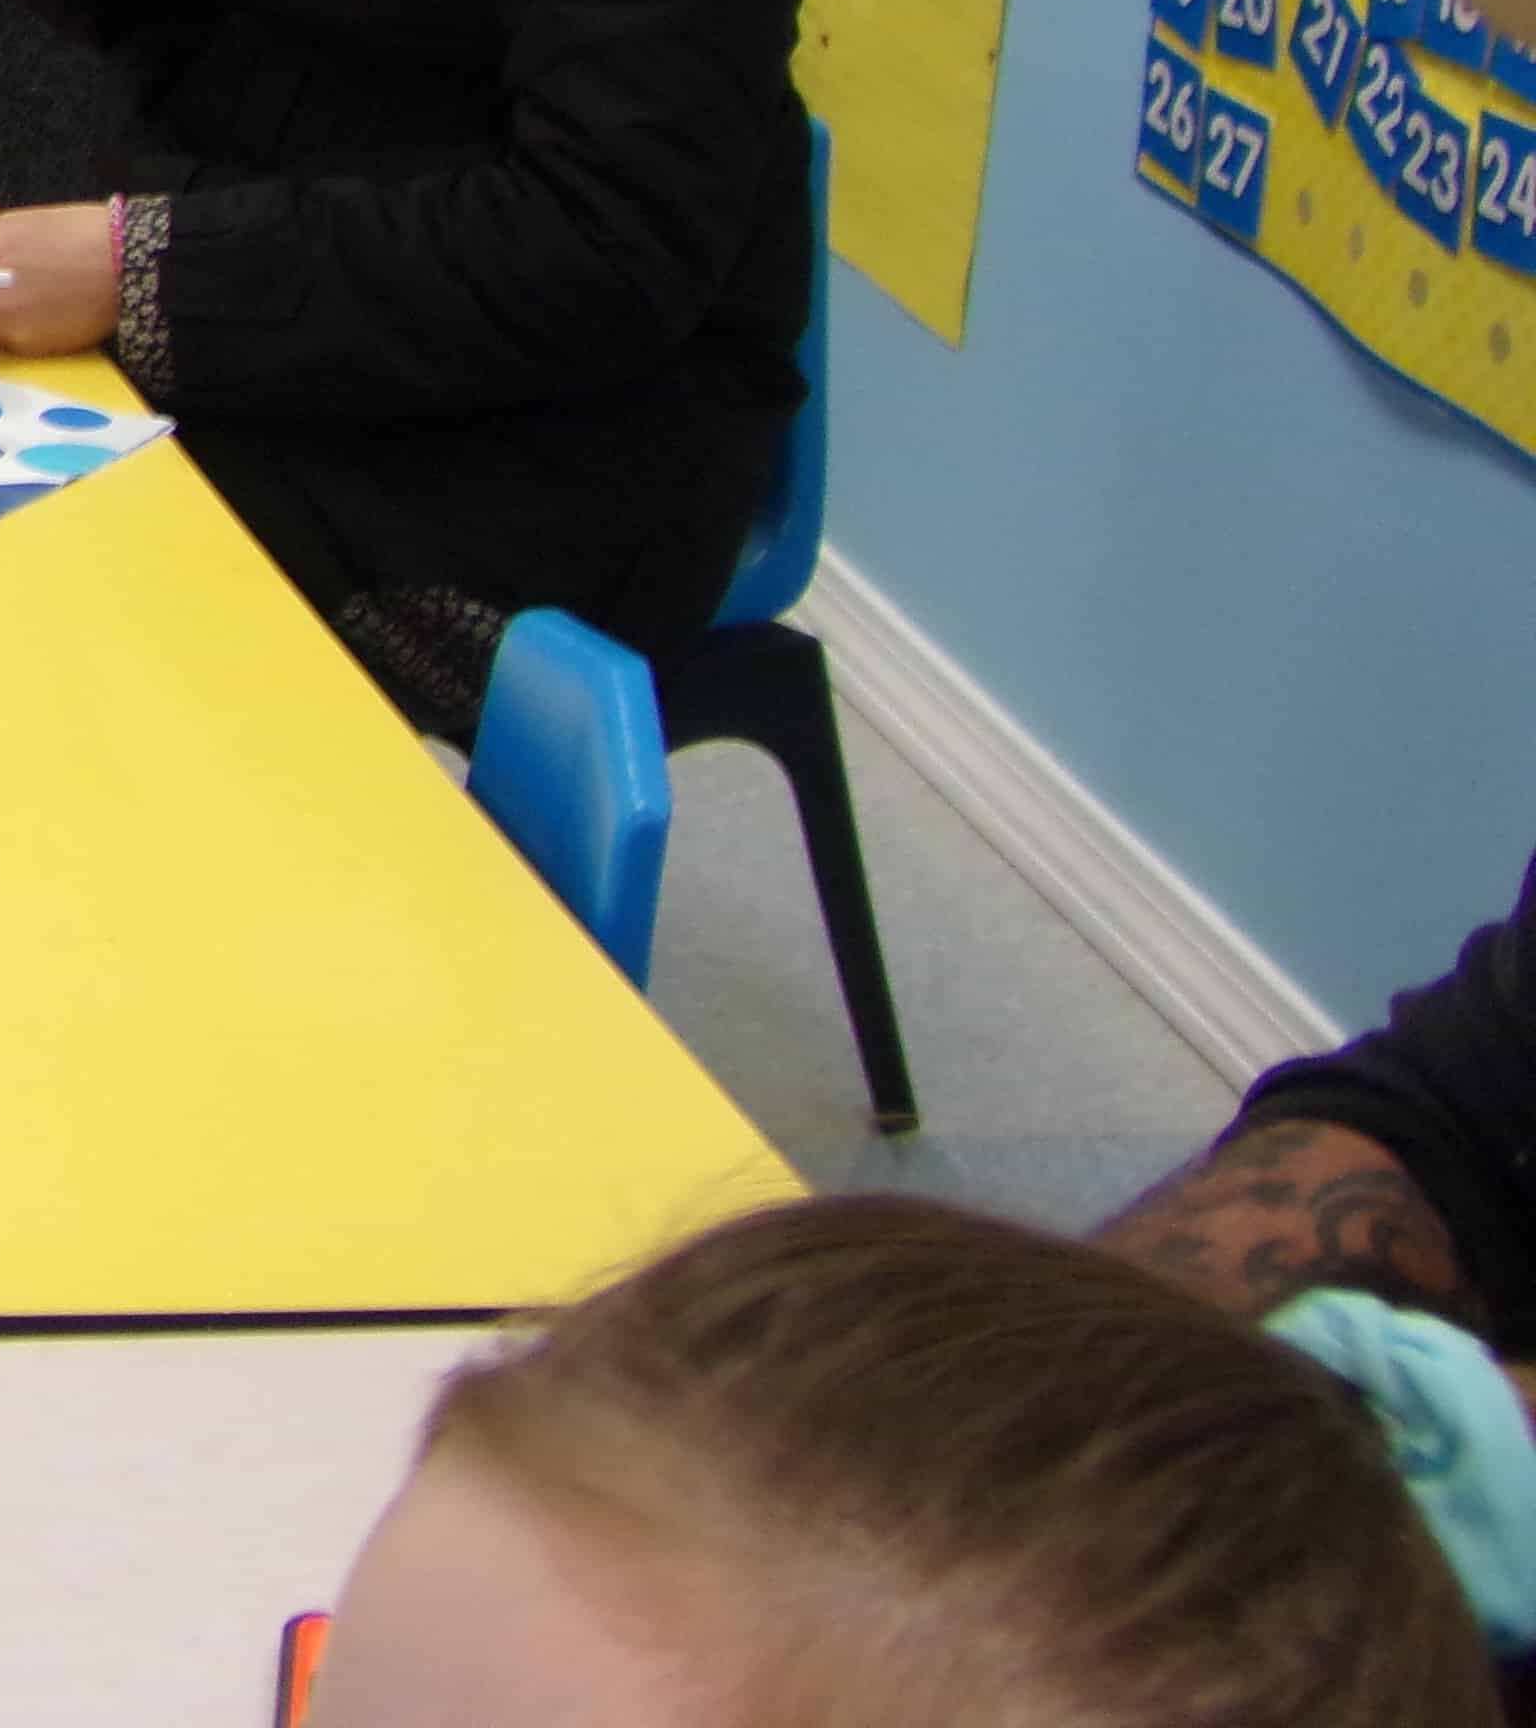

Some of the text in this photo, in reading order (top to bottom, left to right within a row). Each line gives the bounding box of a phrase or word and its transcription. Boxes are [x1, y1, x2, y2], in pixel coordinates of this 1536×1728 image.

[1144, 58, 1265, 199] 26 27
[1355, 42, 1407, 158] 22
[1401, 110, 1460, 214] 23
[1476, 136, 1536, 237] 24
